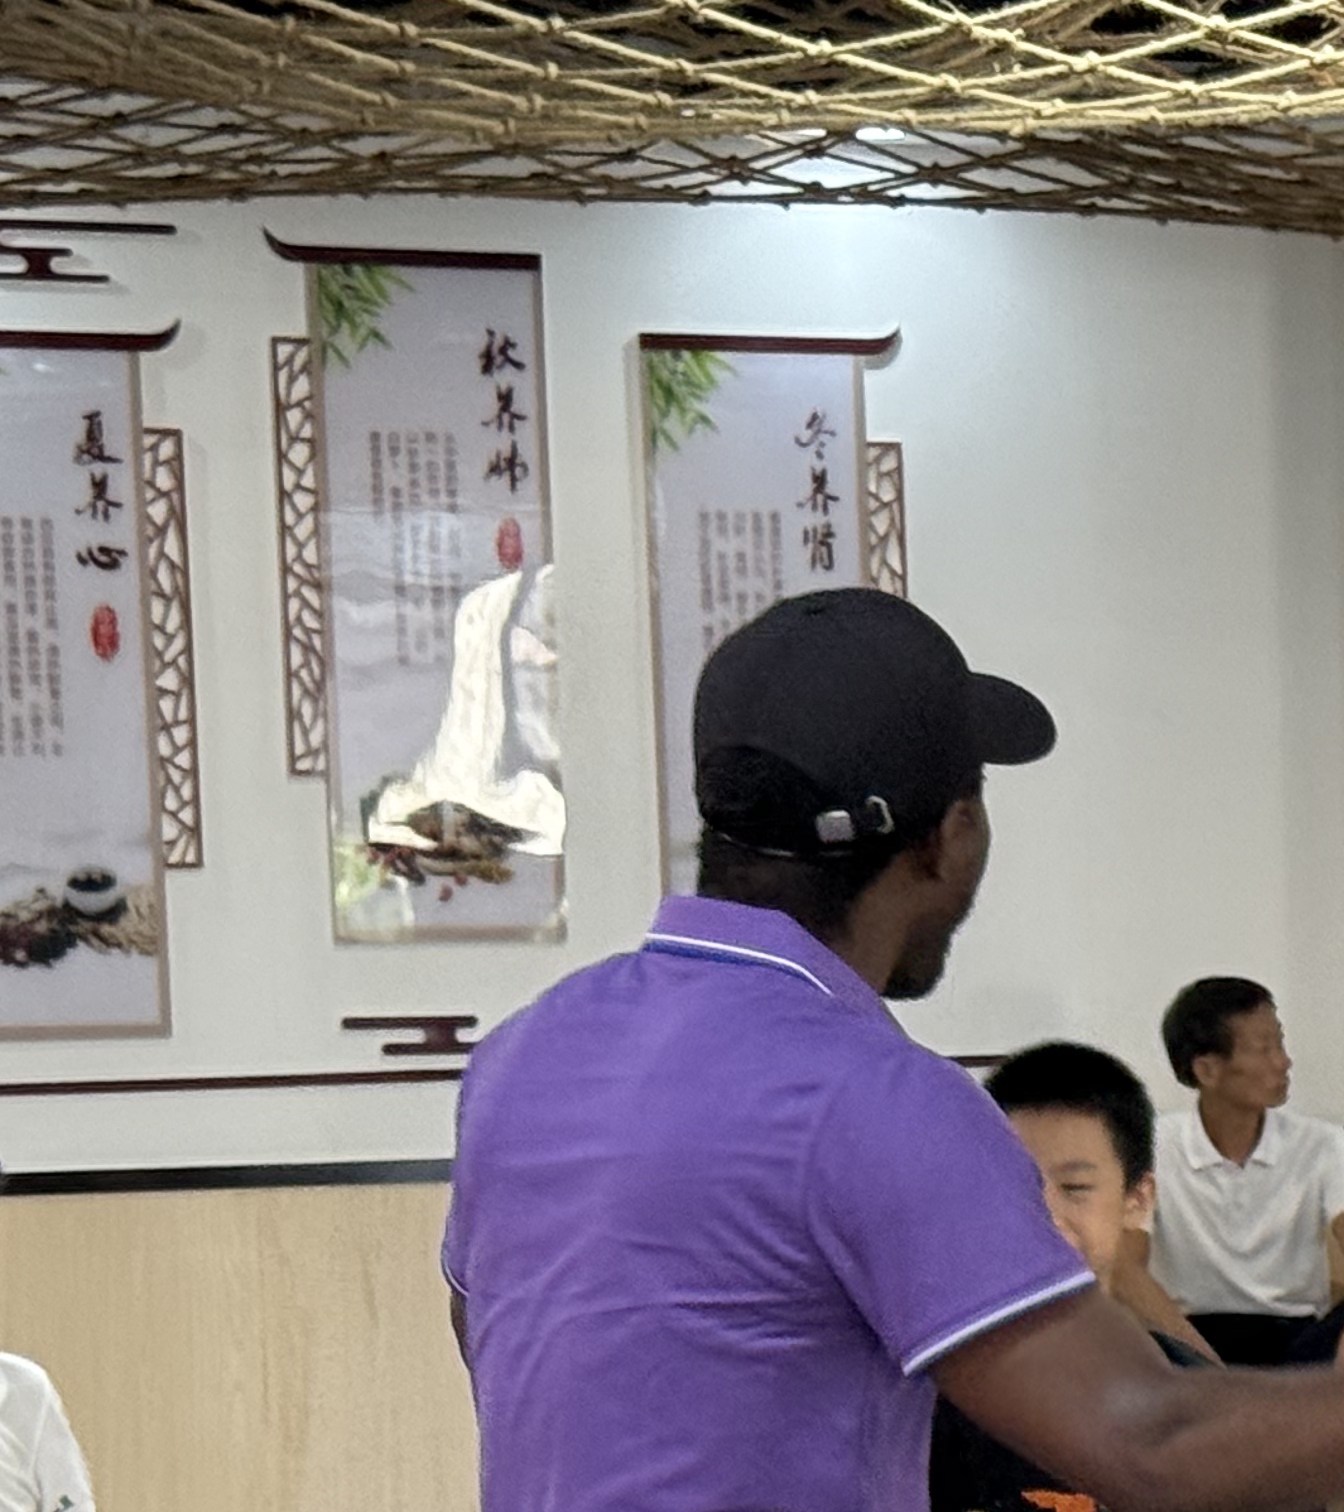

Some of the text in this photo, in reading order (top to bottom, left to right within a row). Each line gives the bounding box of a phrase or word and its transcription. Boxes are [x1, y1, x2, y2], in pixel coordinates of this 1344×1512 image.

[72, 409, 129, 572] 夏养心
[794, 407, 841, 573] 冬养肾
